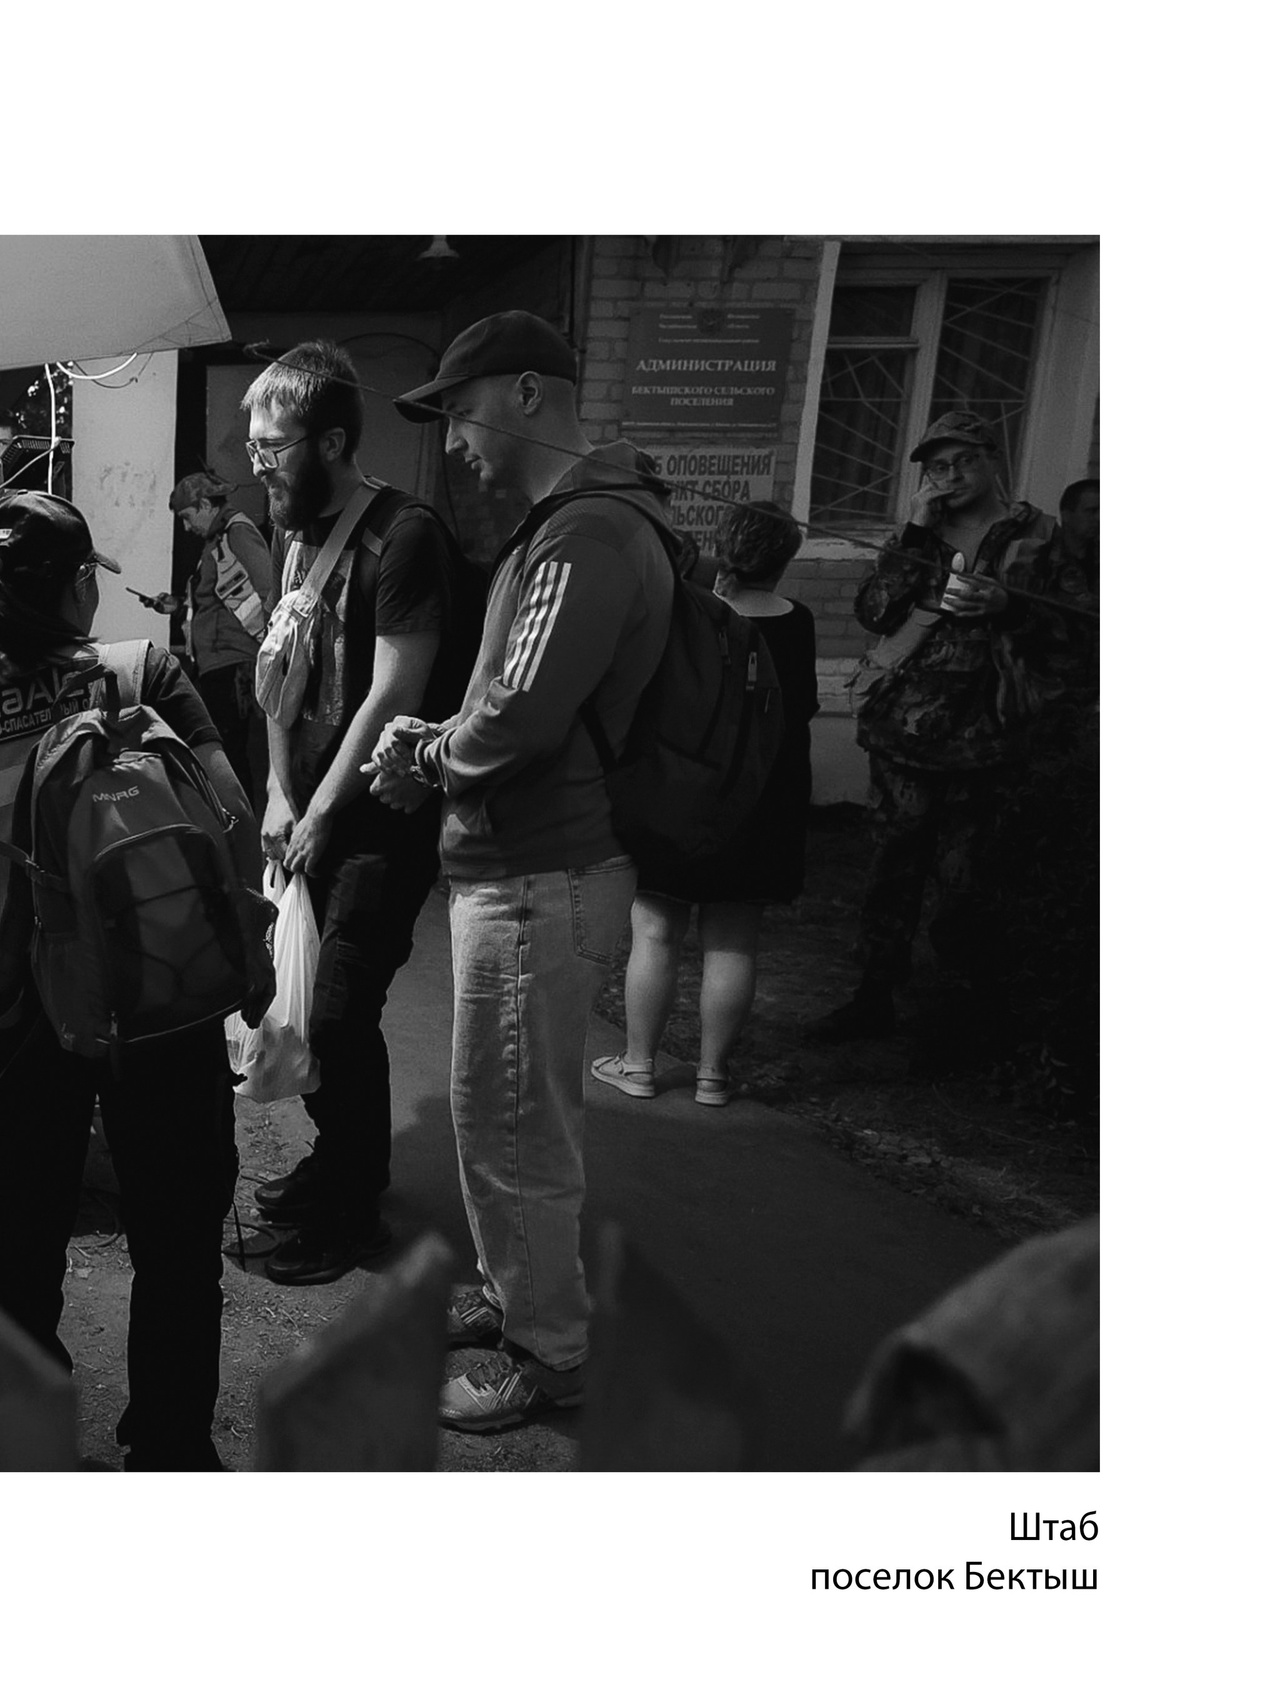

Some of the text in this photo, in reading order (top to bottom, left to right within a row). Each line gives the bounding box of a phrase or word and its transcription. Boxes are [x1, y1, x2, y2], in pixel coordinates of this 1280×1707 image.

[635, 359, 777, 372] АДМИНИСТРАЦИЯ
[714, 386, 776, 396] СЕЛЬСКОГО
[670, 397, 734, 406] ПОСЕЛЕНИЯ
[667, 454, 772, 477] ОПОВЕЩЕНИЯ
[671, 480, 750, 501] НКТ СБОРА
[672, 505, 727, 526] ЬСКОГ
